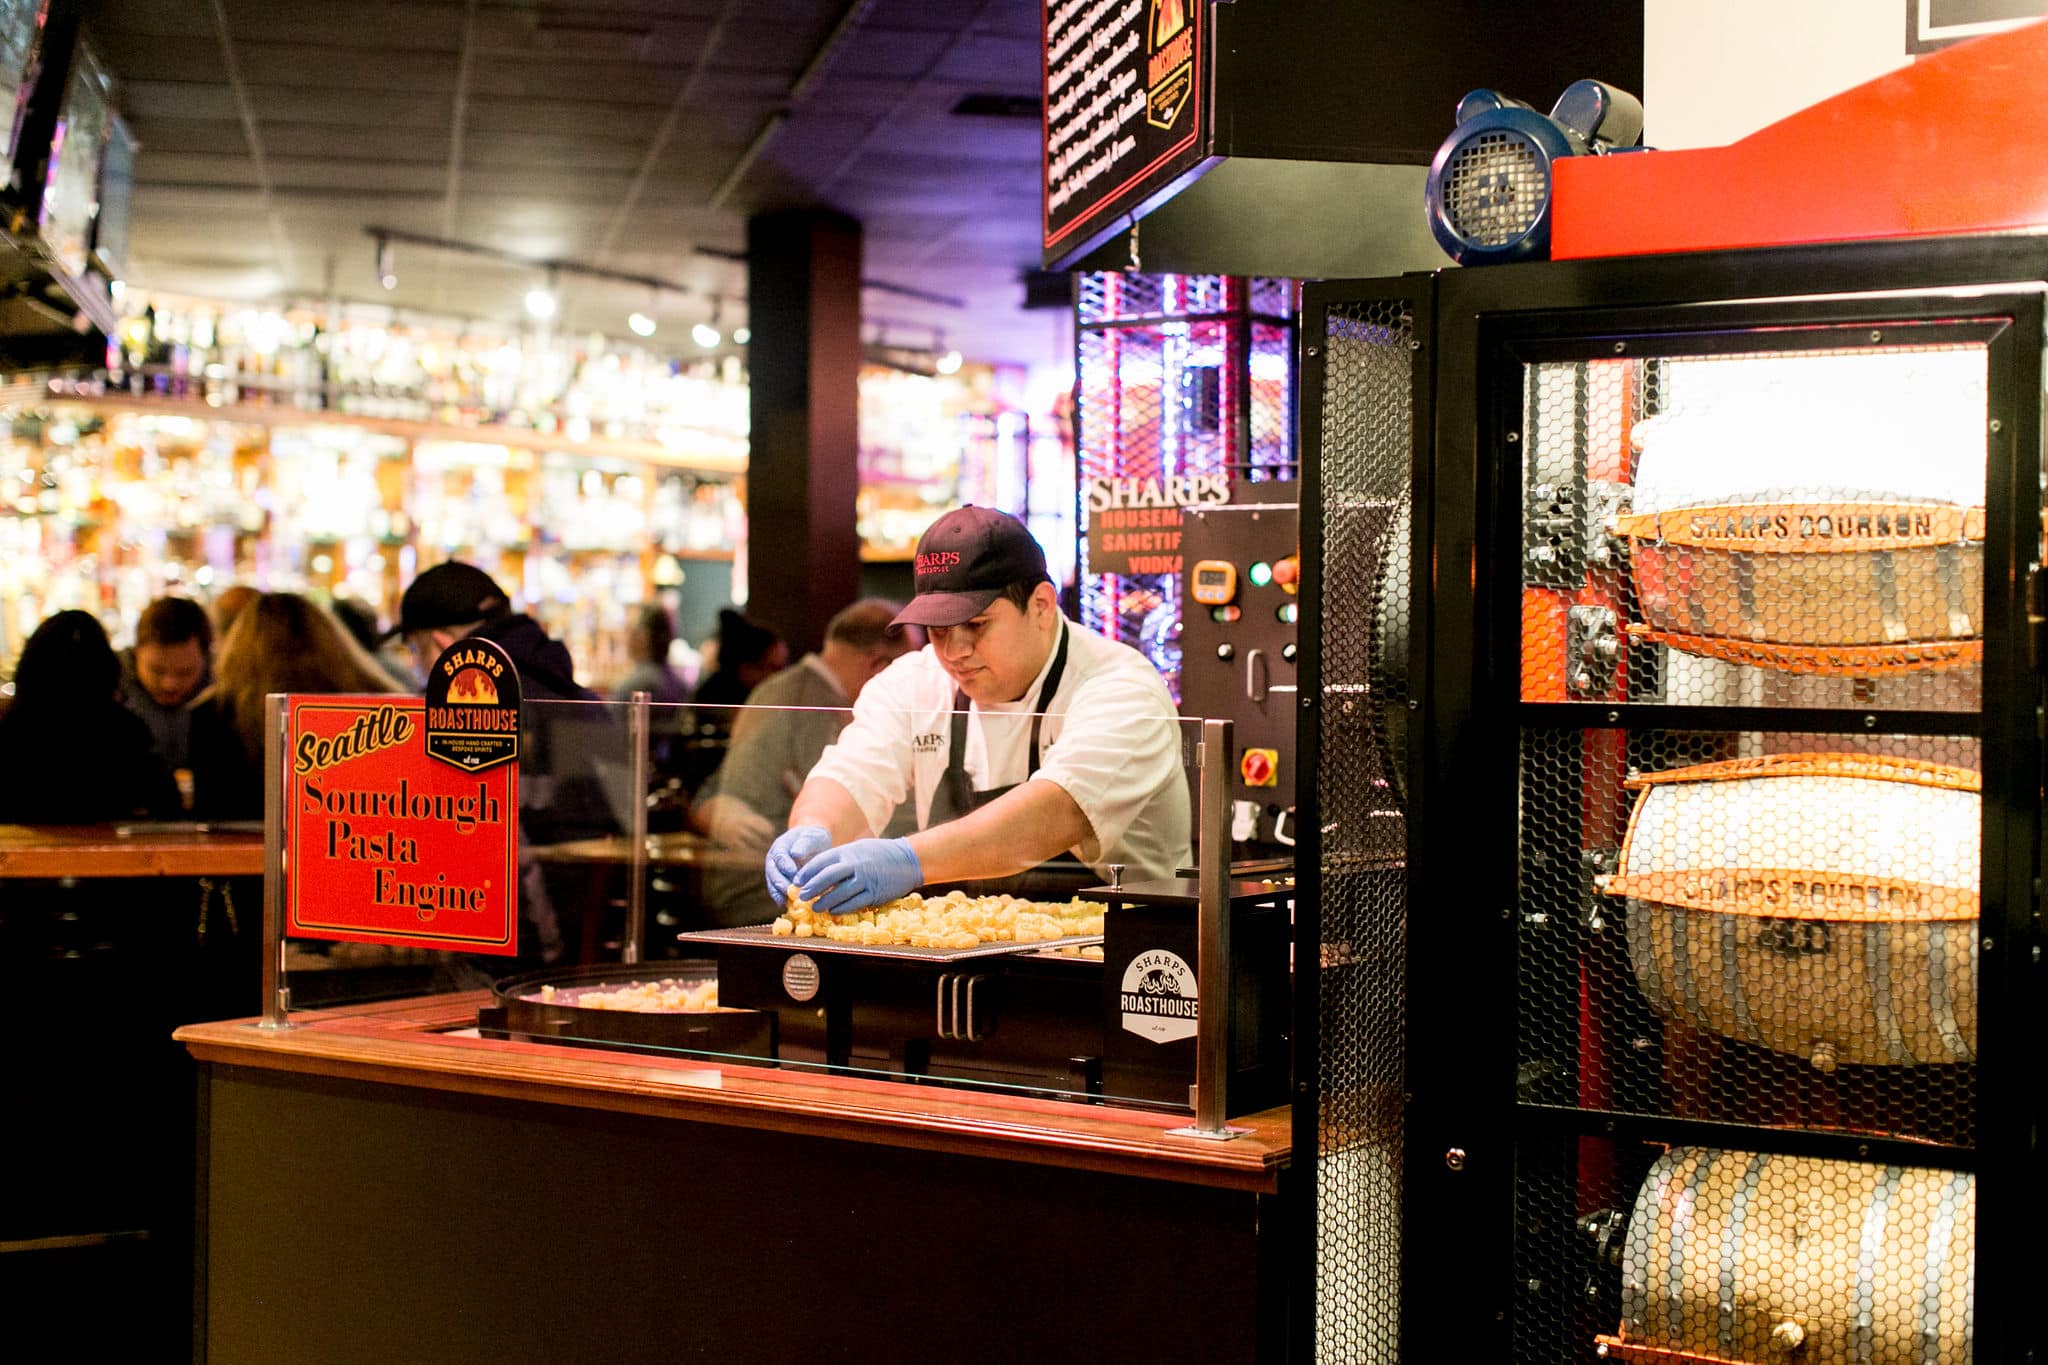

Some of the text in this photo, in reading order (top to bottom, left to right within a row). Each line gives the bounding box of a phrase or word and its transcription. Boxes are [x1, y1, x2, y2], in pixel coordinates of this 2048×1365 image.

[1089, 473, 1231, 513] SHARPS
[1689, 514, 1932, 540] SHARPS BOURBON
[443, 649, 504, 678] SHARPS
[428, 706, 518, 732] ROASTHOUSE
[294, 703, 416, 776] Seattle
[303, 775, 501, 834] Sourdough
[326, 820, 419, 864] Pasta
[373, 867, 487, 922] Engine
[1135, 954, 1187, 977] SHARPS
[1121, 994, 1199, 1017] ROASTHOUSE
